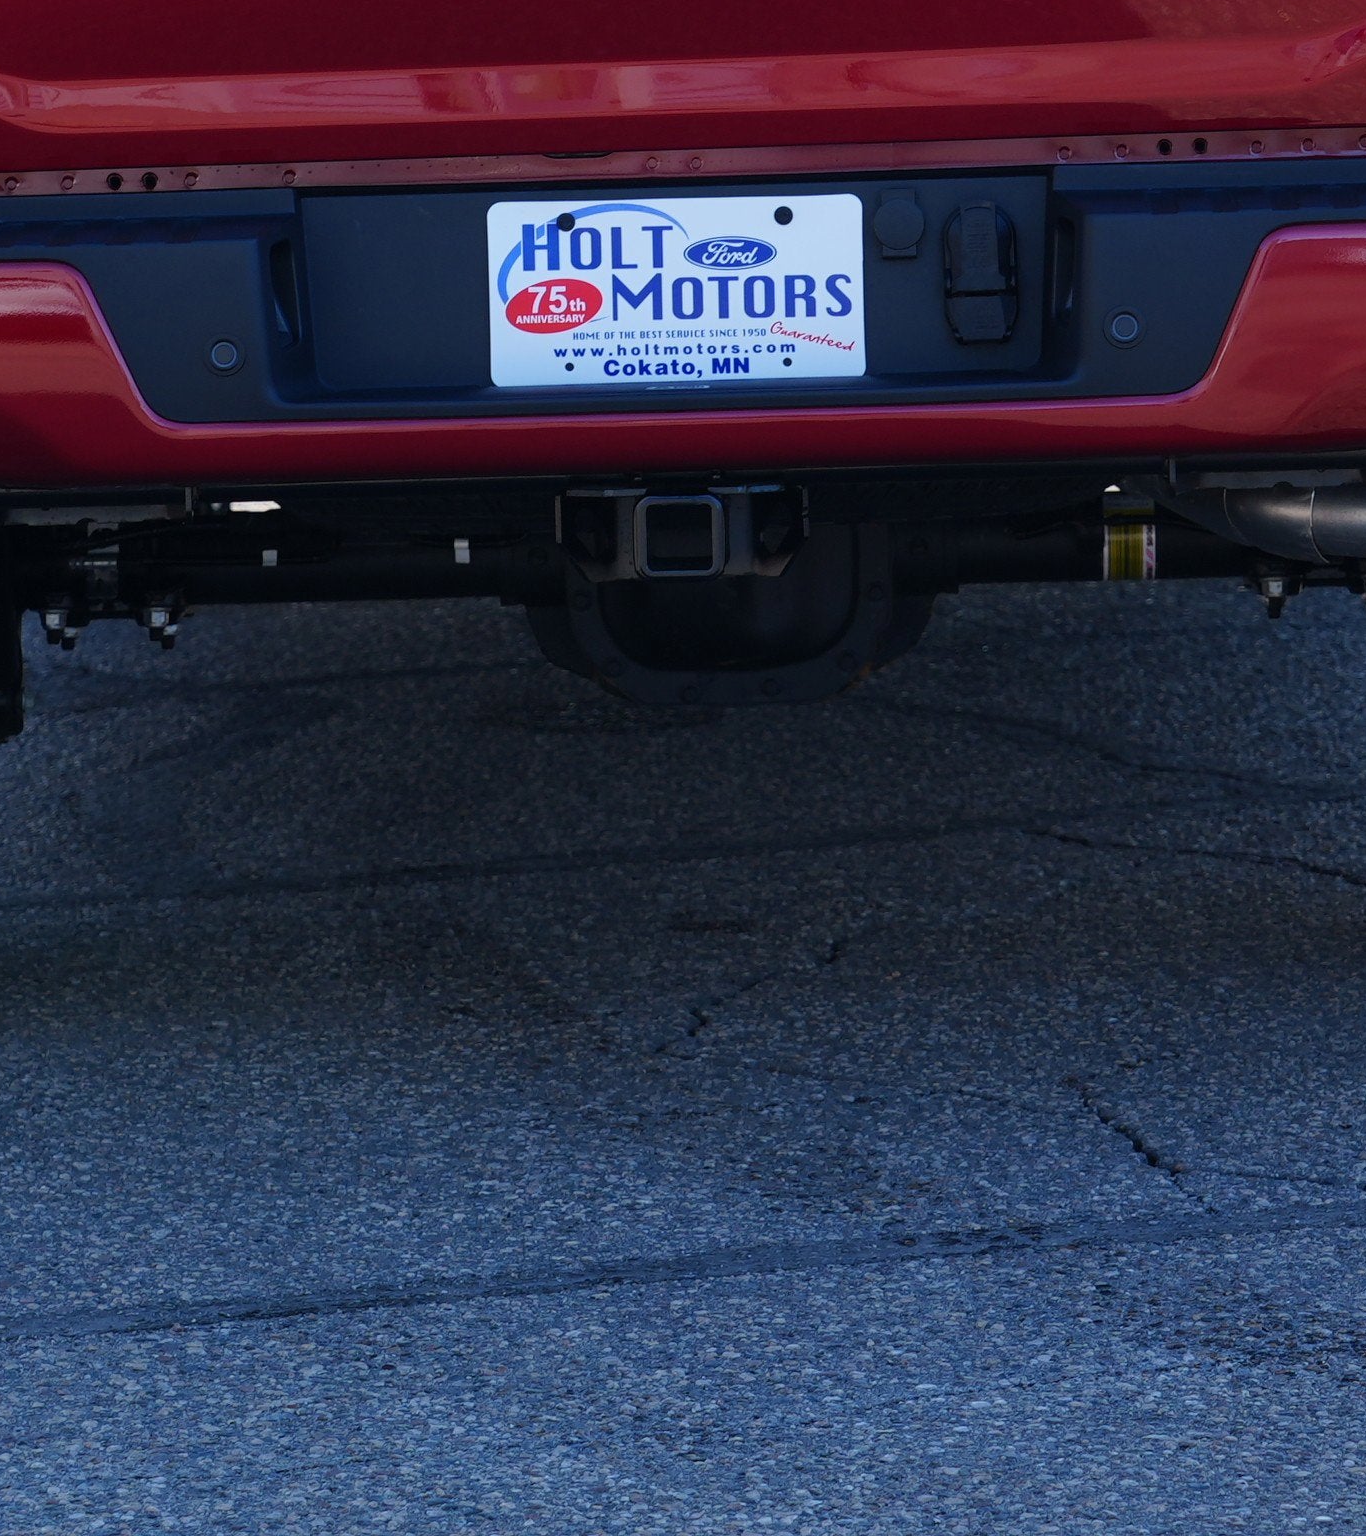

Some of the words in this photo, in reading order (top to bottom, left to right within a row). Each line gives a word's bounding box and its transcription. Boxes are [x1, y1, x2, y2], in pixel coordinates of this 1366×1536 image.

[522, 223, 673, 271] HOLT
[702, 241, 759, 265] Ford
[528, 285, 586, 314] 75th
[612, 272, 853, 322] MOTORS
[515, 313, 586, 325] ANNIVERSARY
[572, 331, 601, 341] HOME
[604, 331, 616, 340] OF
[619, 331, 637, 340] THE
[639, 330, 663, 339] BEST
[665, 329, 706, 339] SERVICE
[709, 328, 738, 338] SINCE
[742, 328, 767, 337] 1950
[769, 320, 856, 352] Guaranteed
[553, 342, 796, 358] www.holtmotors.com
[603, 359, 703, 378] Cokato,
[711, 357, 750, 374] MN
